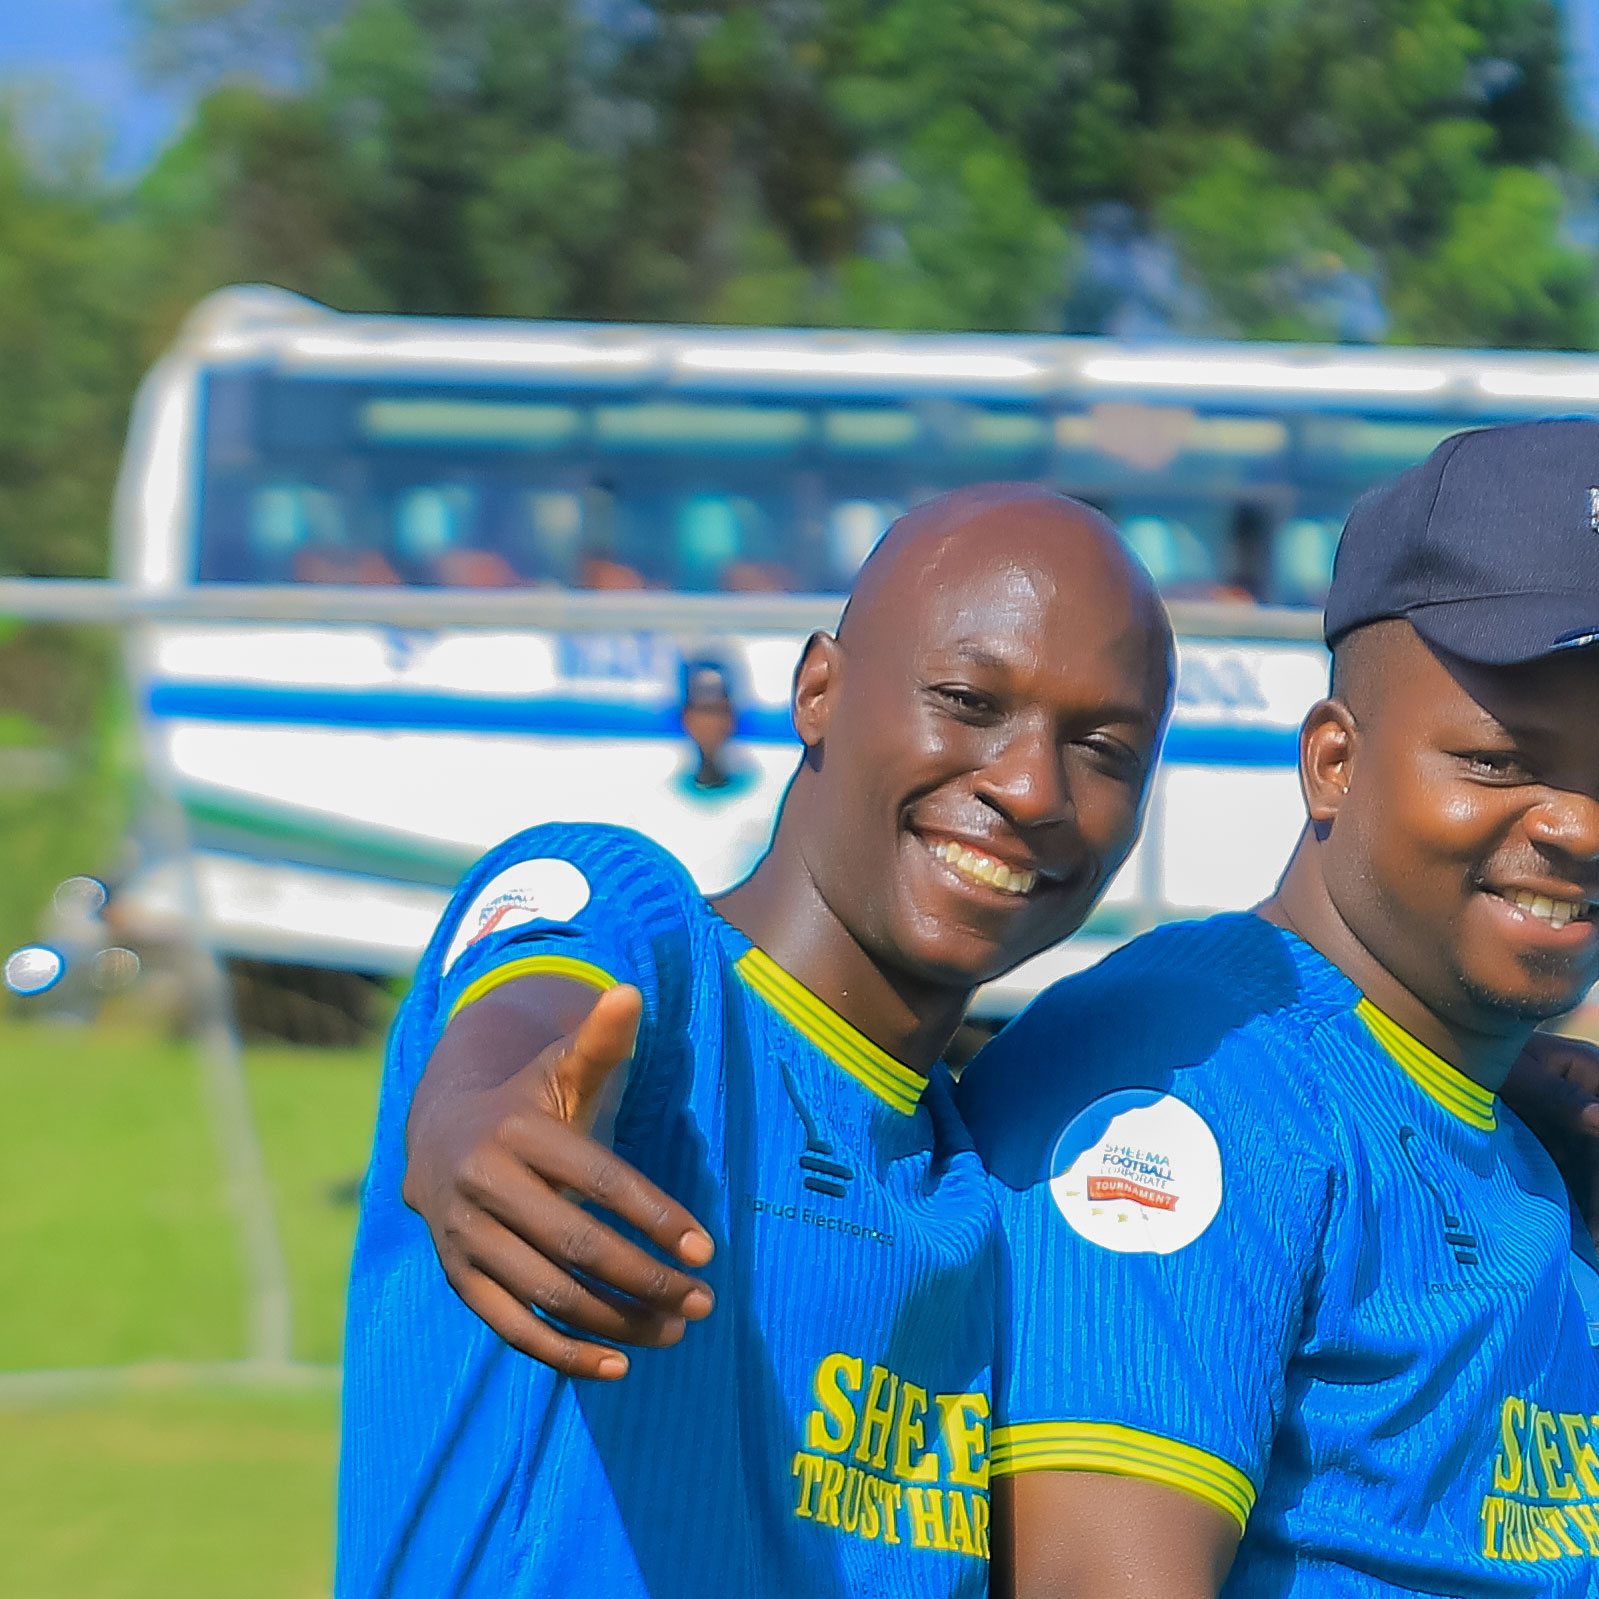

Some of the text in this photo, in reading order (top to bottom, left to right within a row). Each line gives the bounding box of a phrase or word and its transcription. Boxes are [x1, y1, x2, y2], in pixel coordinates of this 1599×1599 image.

[1103, 1154, 1175, 1181] FOOTBALL
[1096, 1181, 1171, 1205] TOURNAMENT
[792, 1451, 901, 1544] TRUST
[1480, 1495, 1584, 1562] TRUST
